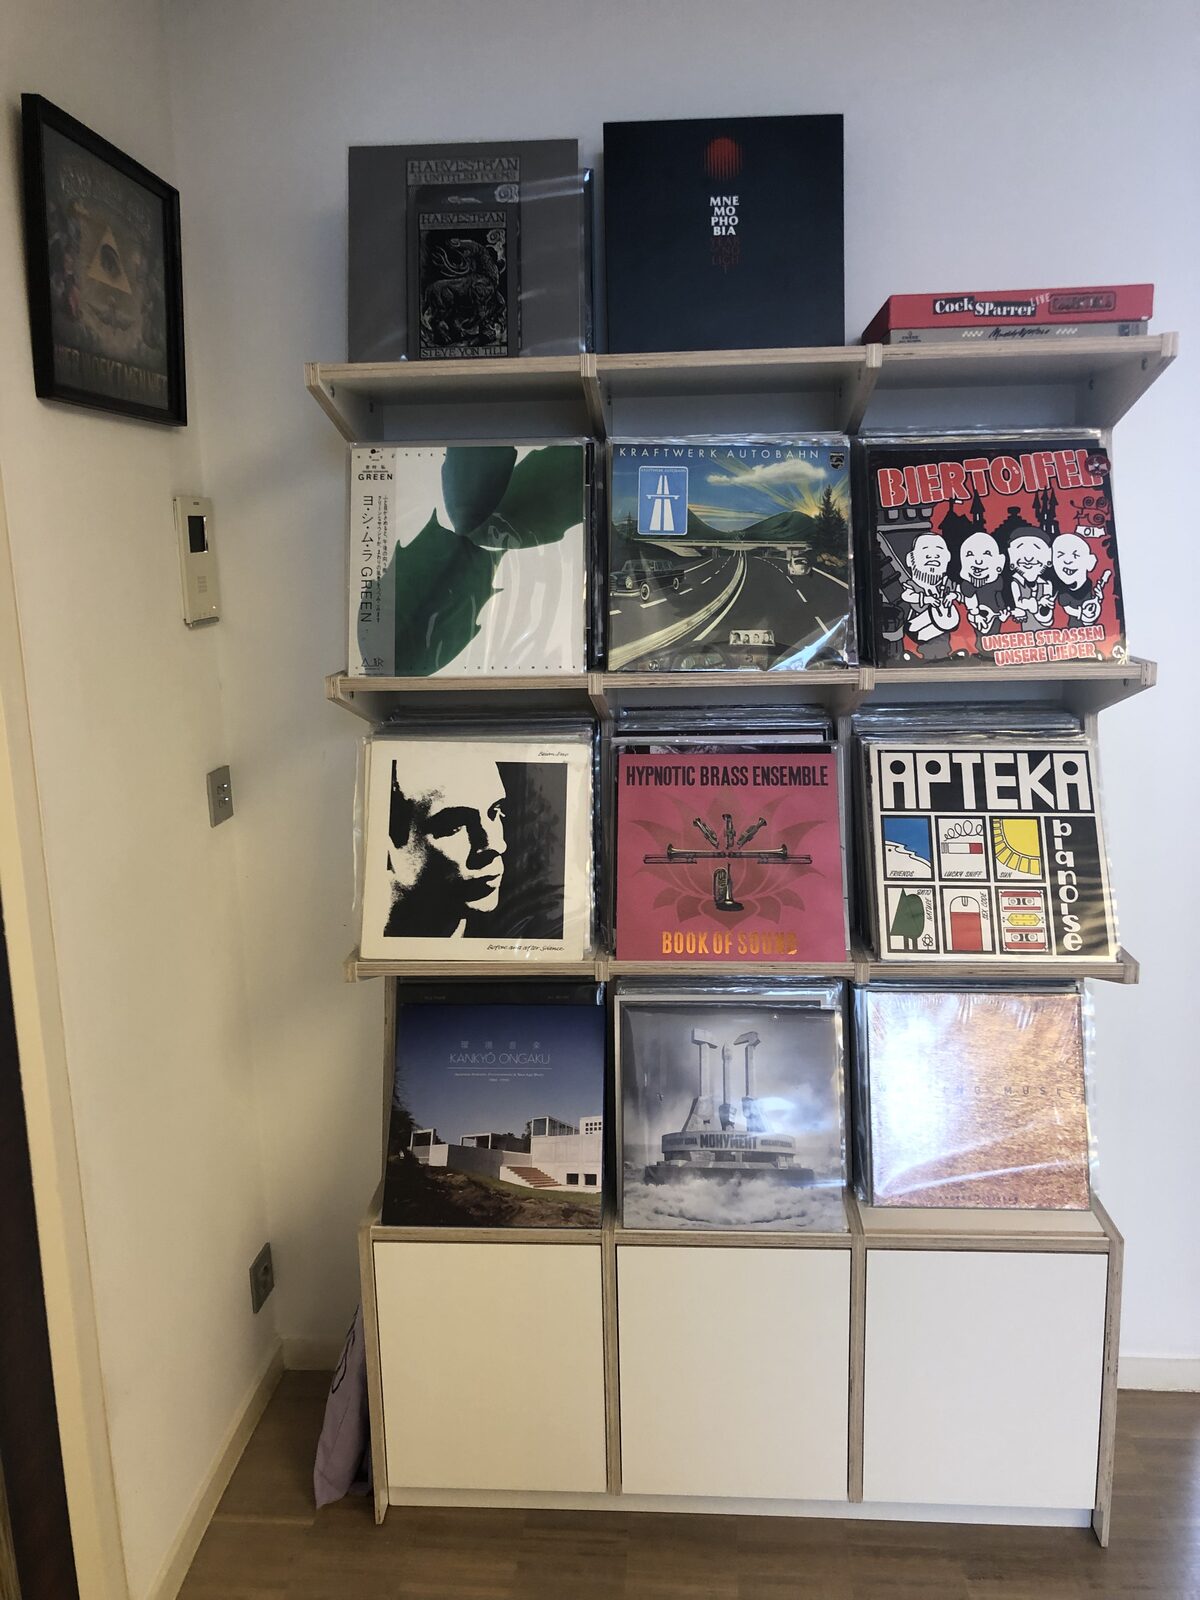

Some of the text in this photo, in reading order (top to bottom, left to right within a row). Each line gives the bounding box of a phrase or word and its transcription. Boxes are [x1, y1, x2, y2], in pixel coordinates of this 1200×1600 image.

[709, 196, 740, 206] MNE
[713, 206, 736, 216] MO
[711, 216, 739, 226] PHO
[713, 226, 736, 236] BIA
[935, 298, 973, 314] Cock
[620, 448, 819, 458] KRAFTWERK AUTOBAHN
[358, 473, 393, 481] GREEN
[360, 566, 373, 623] GREEN
[981, 626, 1104, 651] UNSERE STRASSEN
[994, 643, 1096, 666] UNSERE LIEDER
[626, 766, 828, 786] HYPNOTIC BRASS ENSEMBLE
[880, 752, 1092, 810] APTEKA
[662, 931, 797, 955] BOOK OF SOUND
[498, 1053, 551, 1065] ONGAKU
